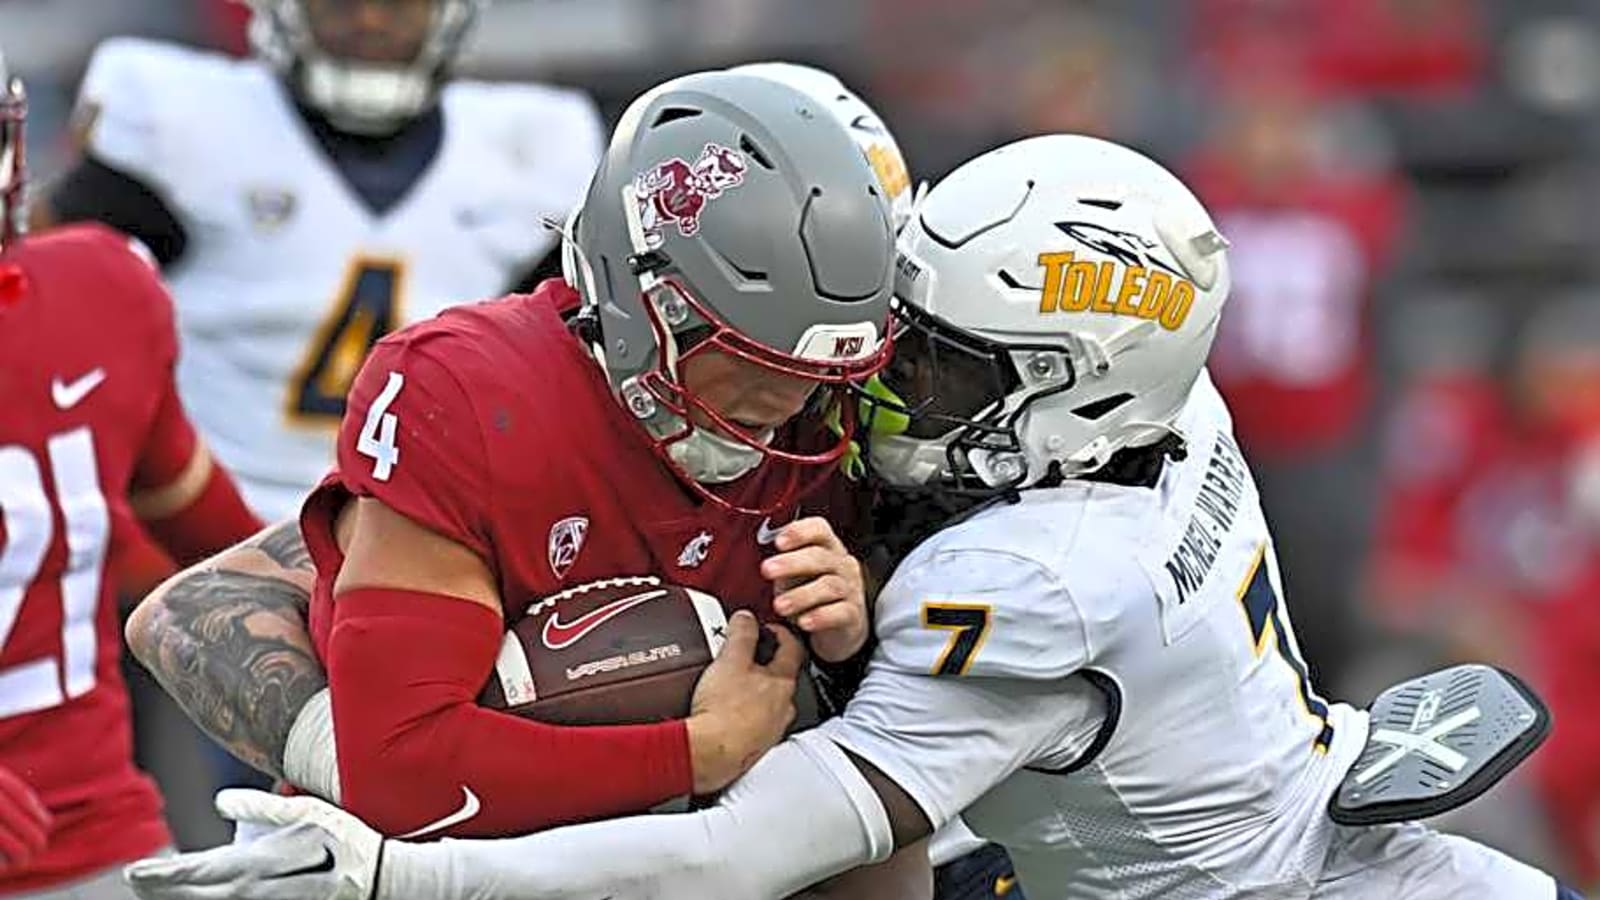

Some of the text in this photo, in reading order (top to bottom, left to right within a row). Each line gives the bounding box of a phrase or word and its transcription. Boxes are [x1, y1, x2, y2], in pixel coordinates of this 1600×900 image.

[1038, 252, 1196, 332] TOLEDO
[286, 258, 403, 428] 4
[834, 336, 864, 357] WSU
[356, 371, 404, 481] 4
[0, 425, 110, 719] 21
[919, 601, 992, 677] 7
